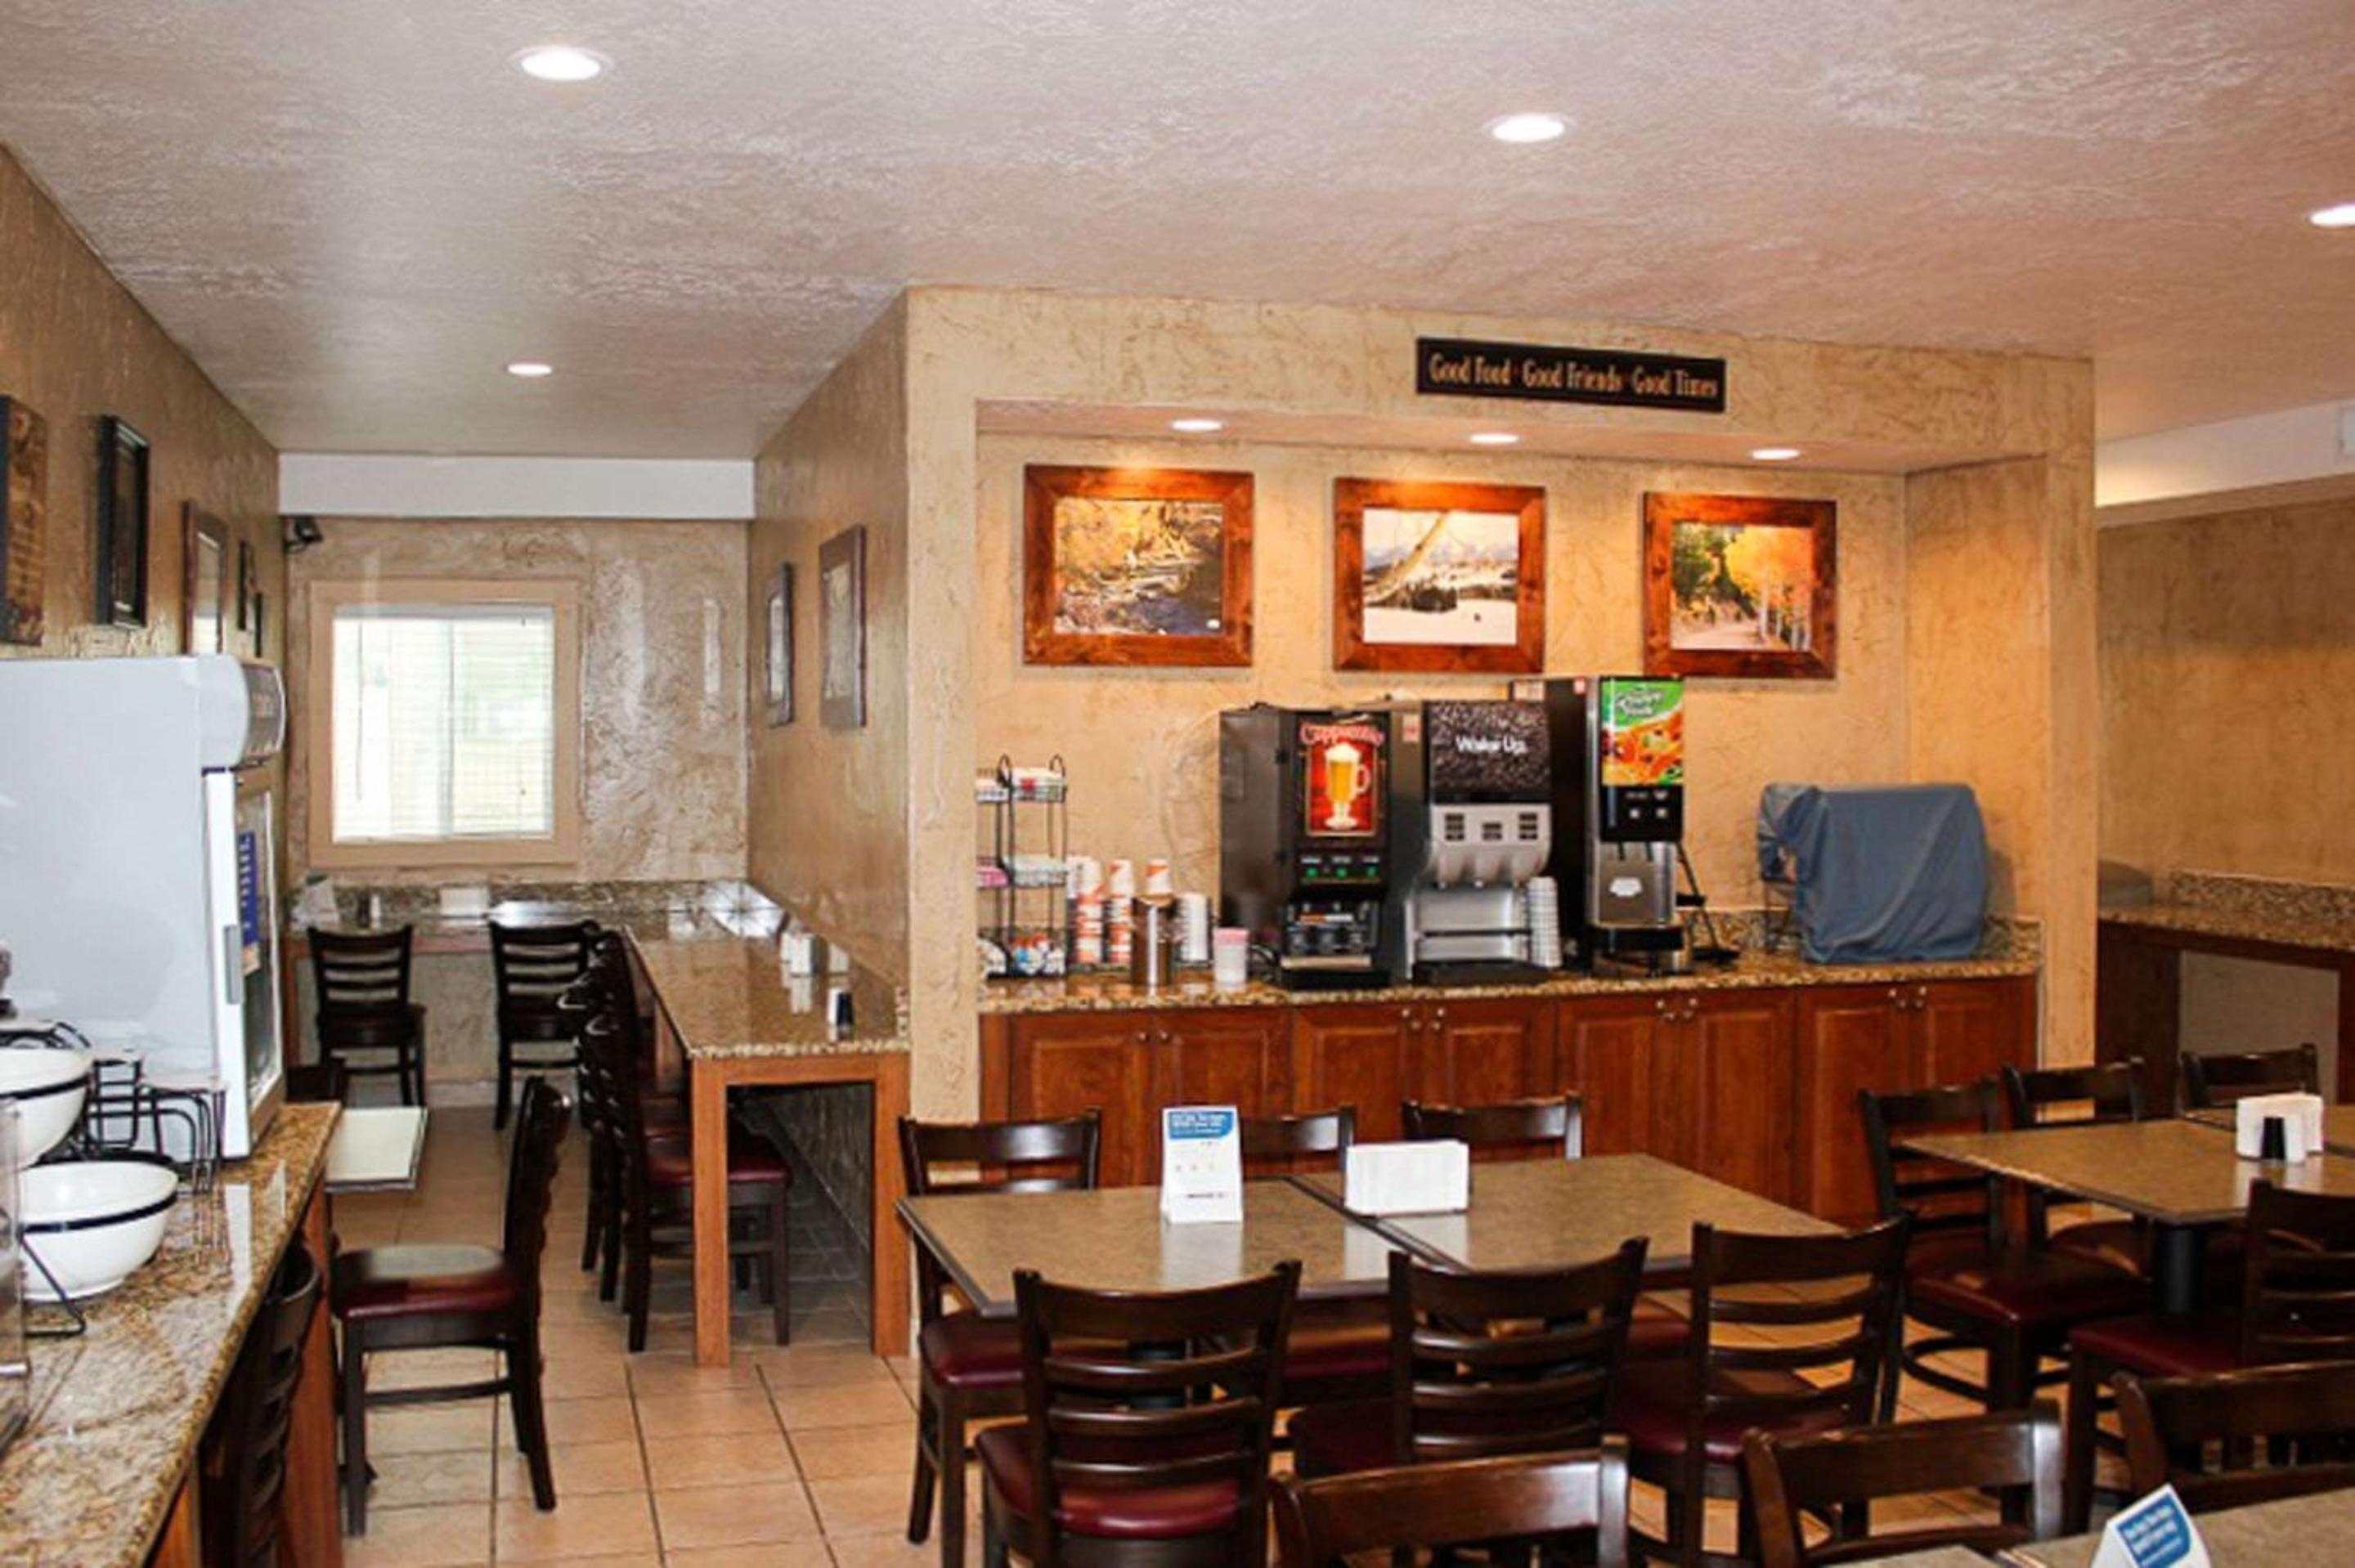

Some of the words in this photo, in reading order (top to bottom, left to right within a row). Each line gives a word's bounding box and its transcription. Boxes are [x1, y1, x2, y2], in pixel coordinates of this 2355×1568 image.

[1429, 352, 1470, 383] Good
[1475, 356, 1510, 385] Food
[1523, 360, 1563, 388] Good
[1568, 362, 1622, 392] Friends
[1632, 365, 1671, 395] Good
[1675, 370, 1717, 397] Times
[1456, 735, 1500, 753] Wake
